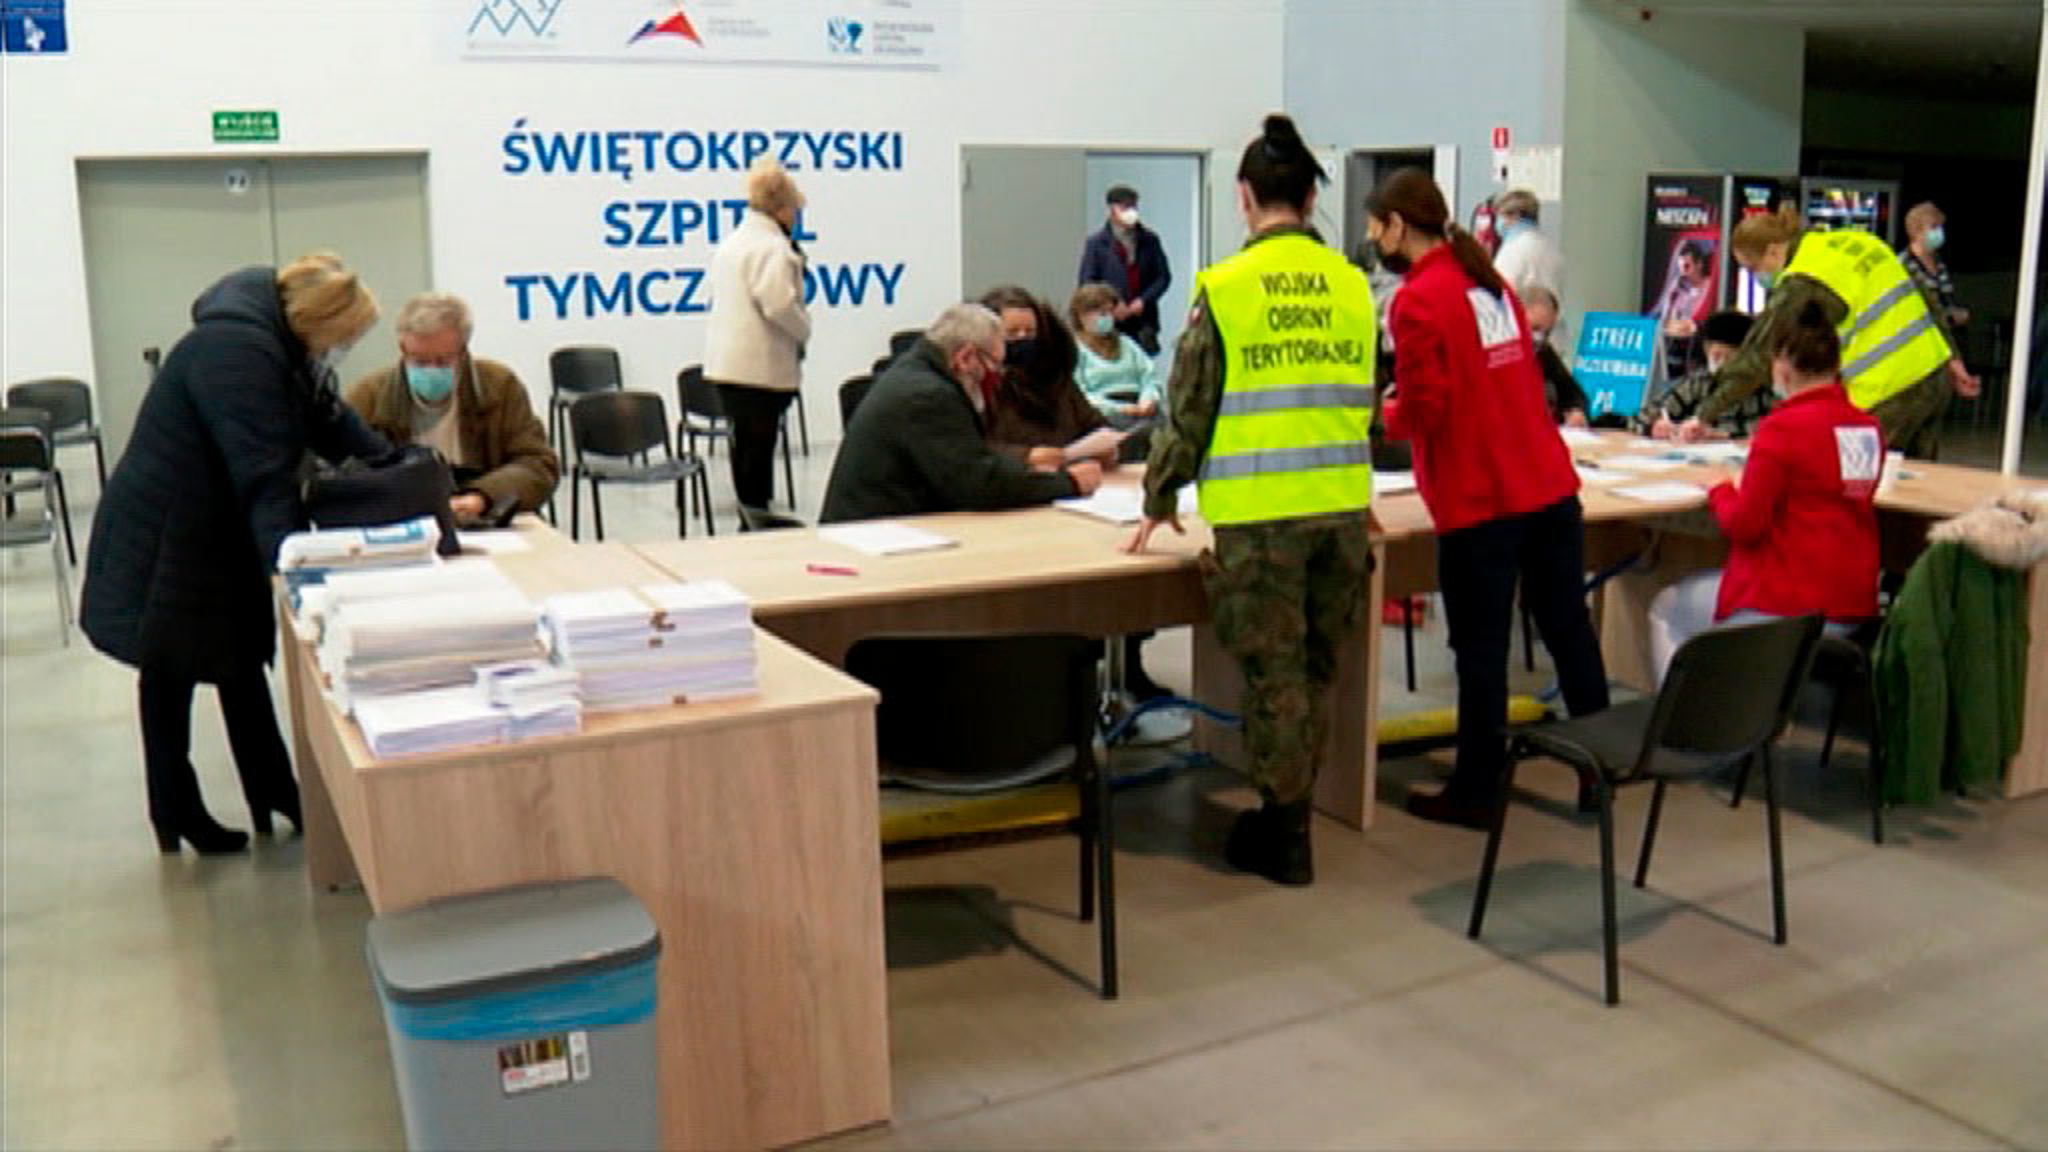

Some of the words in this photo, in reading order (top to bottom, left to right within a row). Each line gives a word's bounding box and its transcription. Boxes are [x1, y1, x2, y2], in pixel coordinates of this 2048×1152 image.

[503, 118, 904, 181] ŚWIĘTOKRZYSKI
[604, 199, 817, 247] SZPITL
[505, 263, 905, 321] TYMCZWY
[1260, 271, 1330, 297] WOJSKA
[1267, 305, 1333, 332] OBRONY
